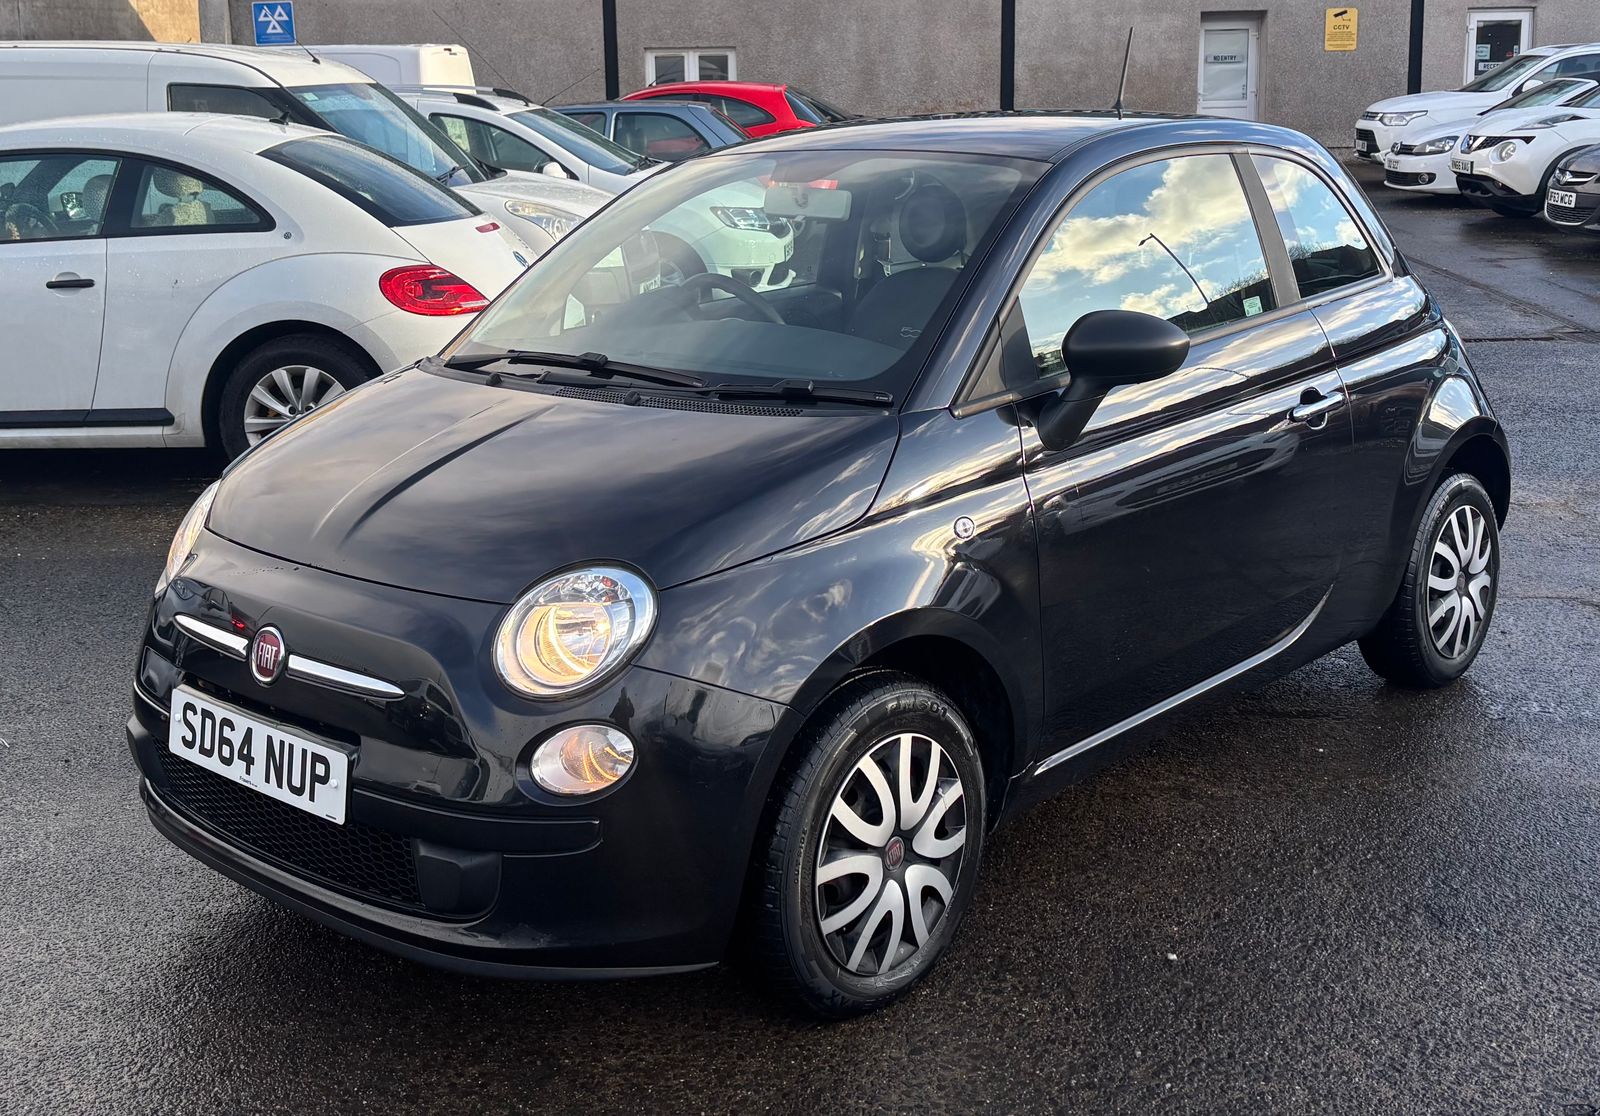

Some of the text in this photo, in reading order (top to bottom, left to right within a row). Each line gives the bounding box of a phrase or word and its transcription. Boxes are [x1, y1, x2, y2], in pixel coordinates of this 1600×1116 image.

[257, 642, 278, 669] FIAT
[181, 701, 331, 803] SD64 NUP
